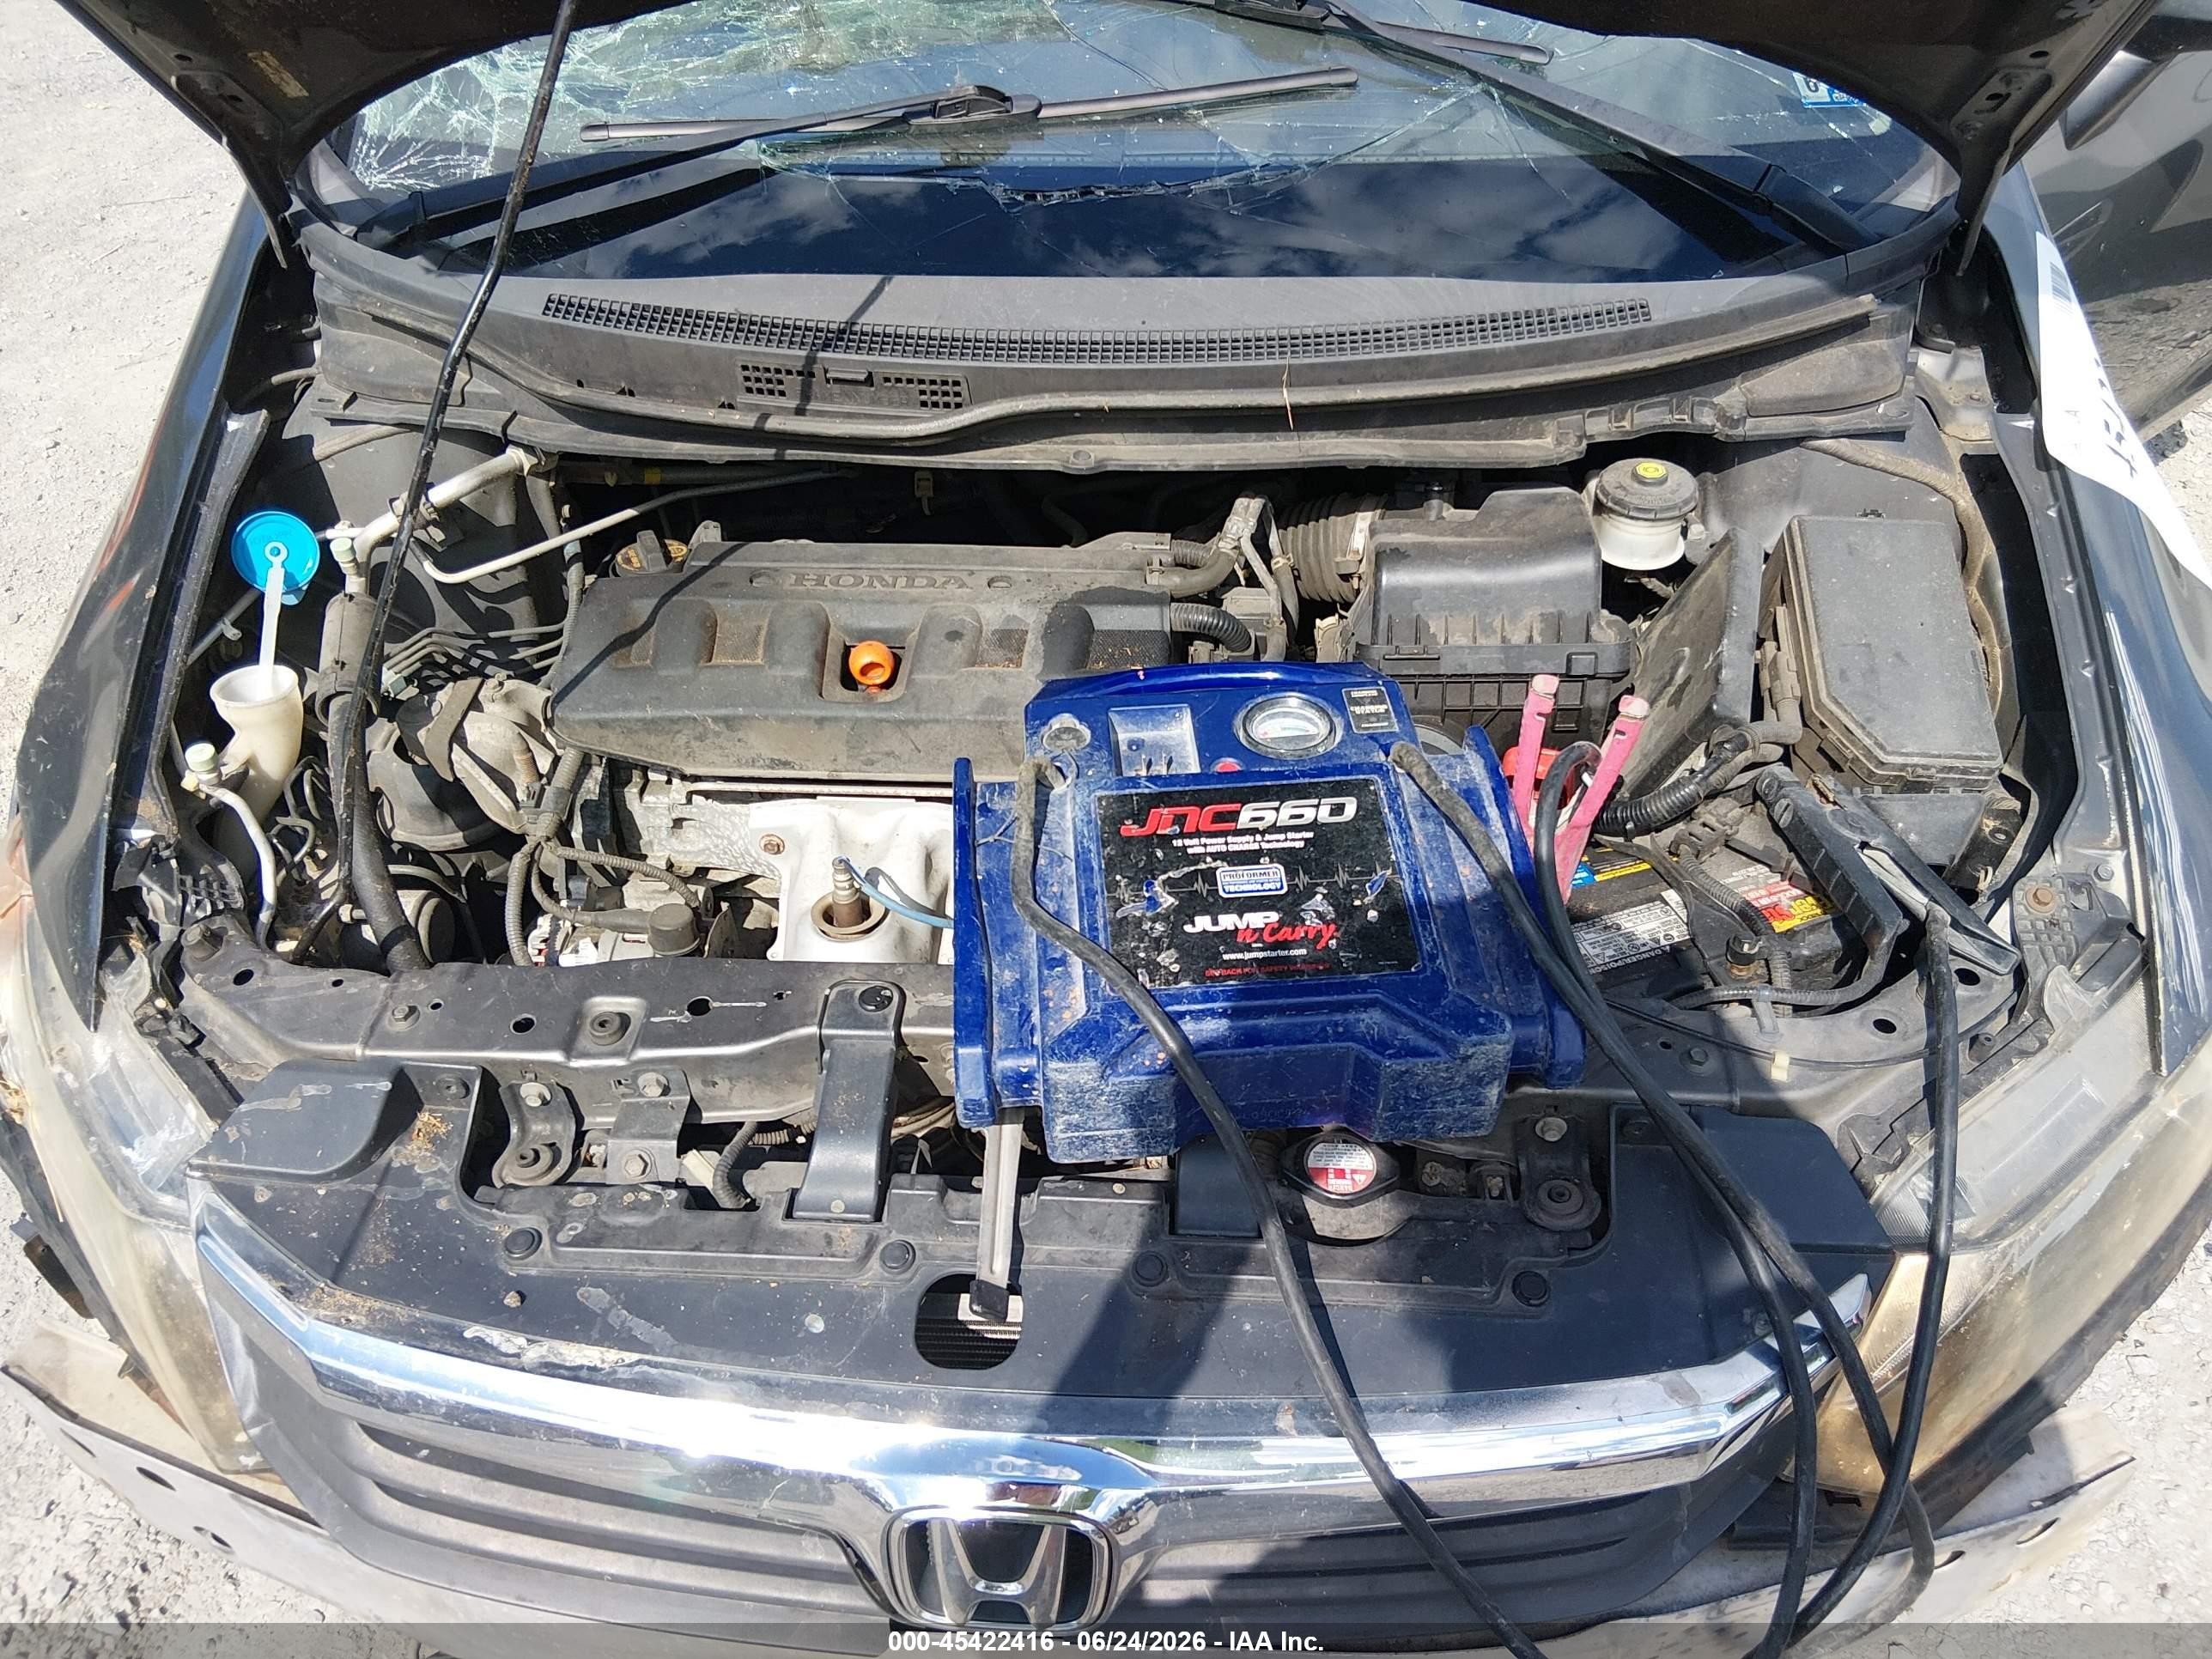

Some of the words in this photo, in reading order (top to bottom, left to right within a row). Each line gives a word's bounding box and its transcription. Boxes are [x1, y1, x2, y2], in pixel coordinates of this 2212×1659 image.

[789, 572, 975, 591] HONDA
[1120, 797, 1357, 837] JNC660
[1187, 846, 1206, 854] with
[1206, 844, 1227, 854] AUTO
[1227, 842, 1261, 852] CHARGE
[1261, 840, 1305, 850] Technology
[1200, 836, 1226, 846] Power
[1227, 835, 1255, 844] Supply
[1263, 833, 1285, 842] Jump
[1286, 831, 1315, 841] Starter
[1223, 882, 1282, 893] TECHNOLOGY
[1182, 911, 1280, 933] JUMP
[1237, 927, 1260, 943] n
[1262, 922, 1337, 951] Carry
[1222, 948, 1308, 961] www.jumpstarter.com
[1588, 947, 1662, 975] DANGER/POISON
